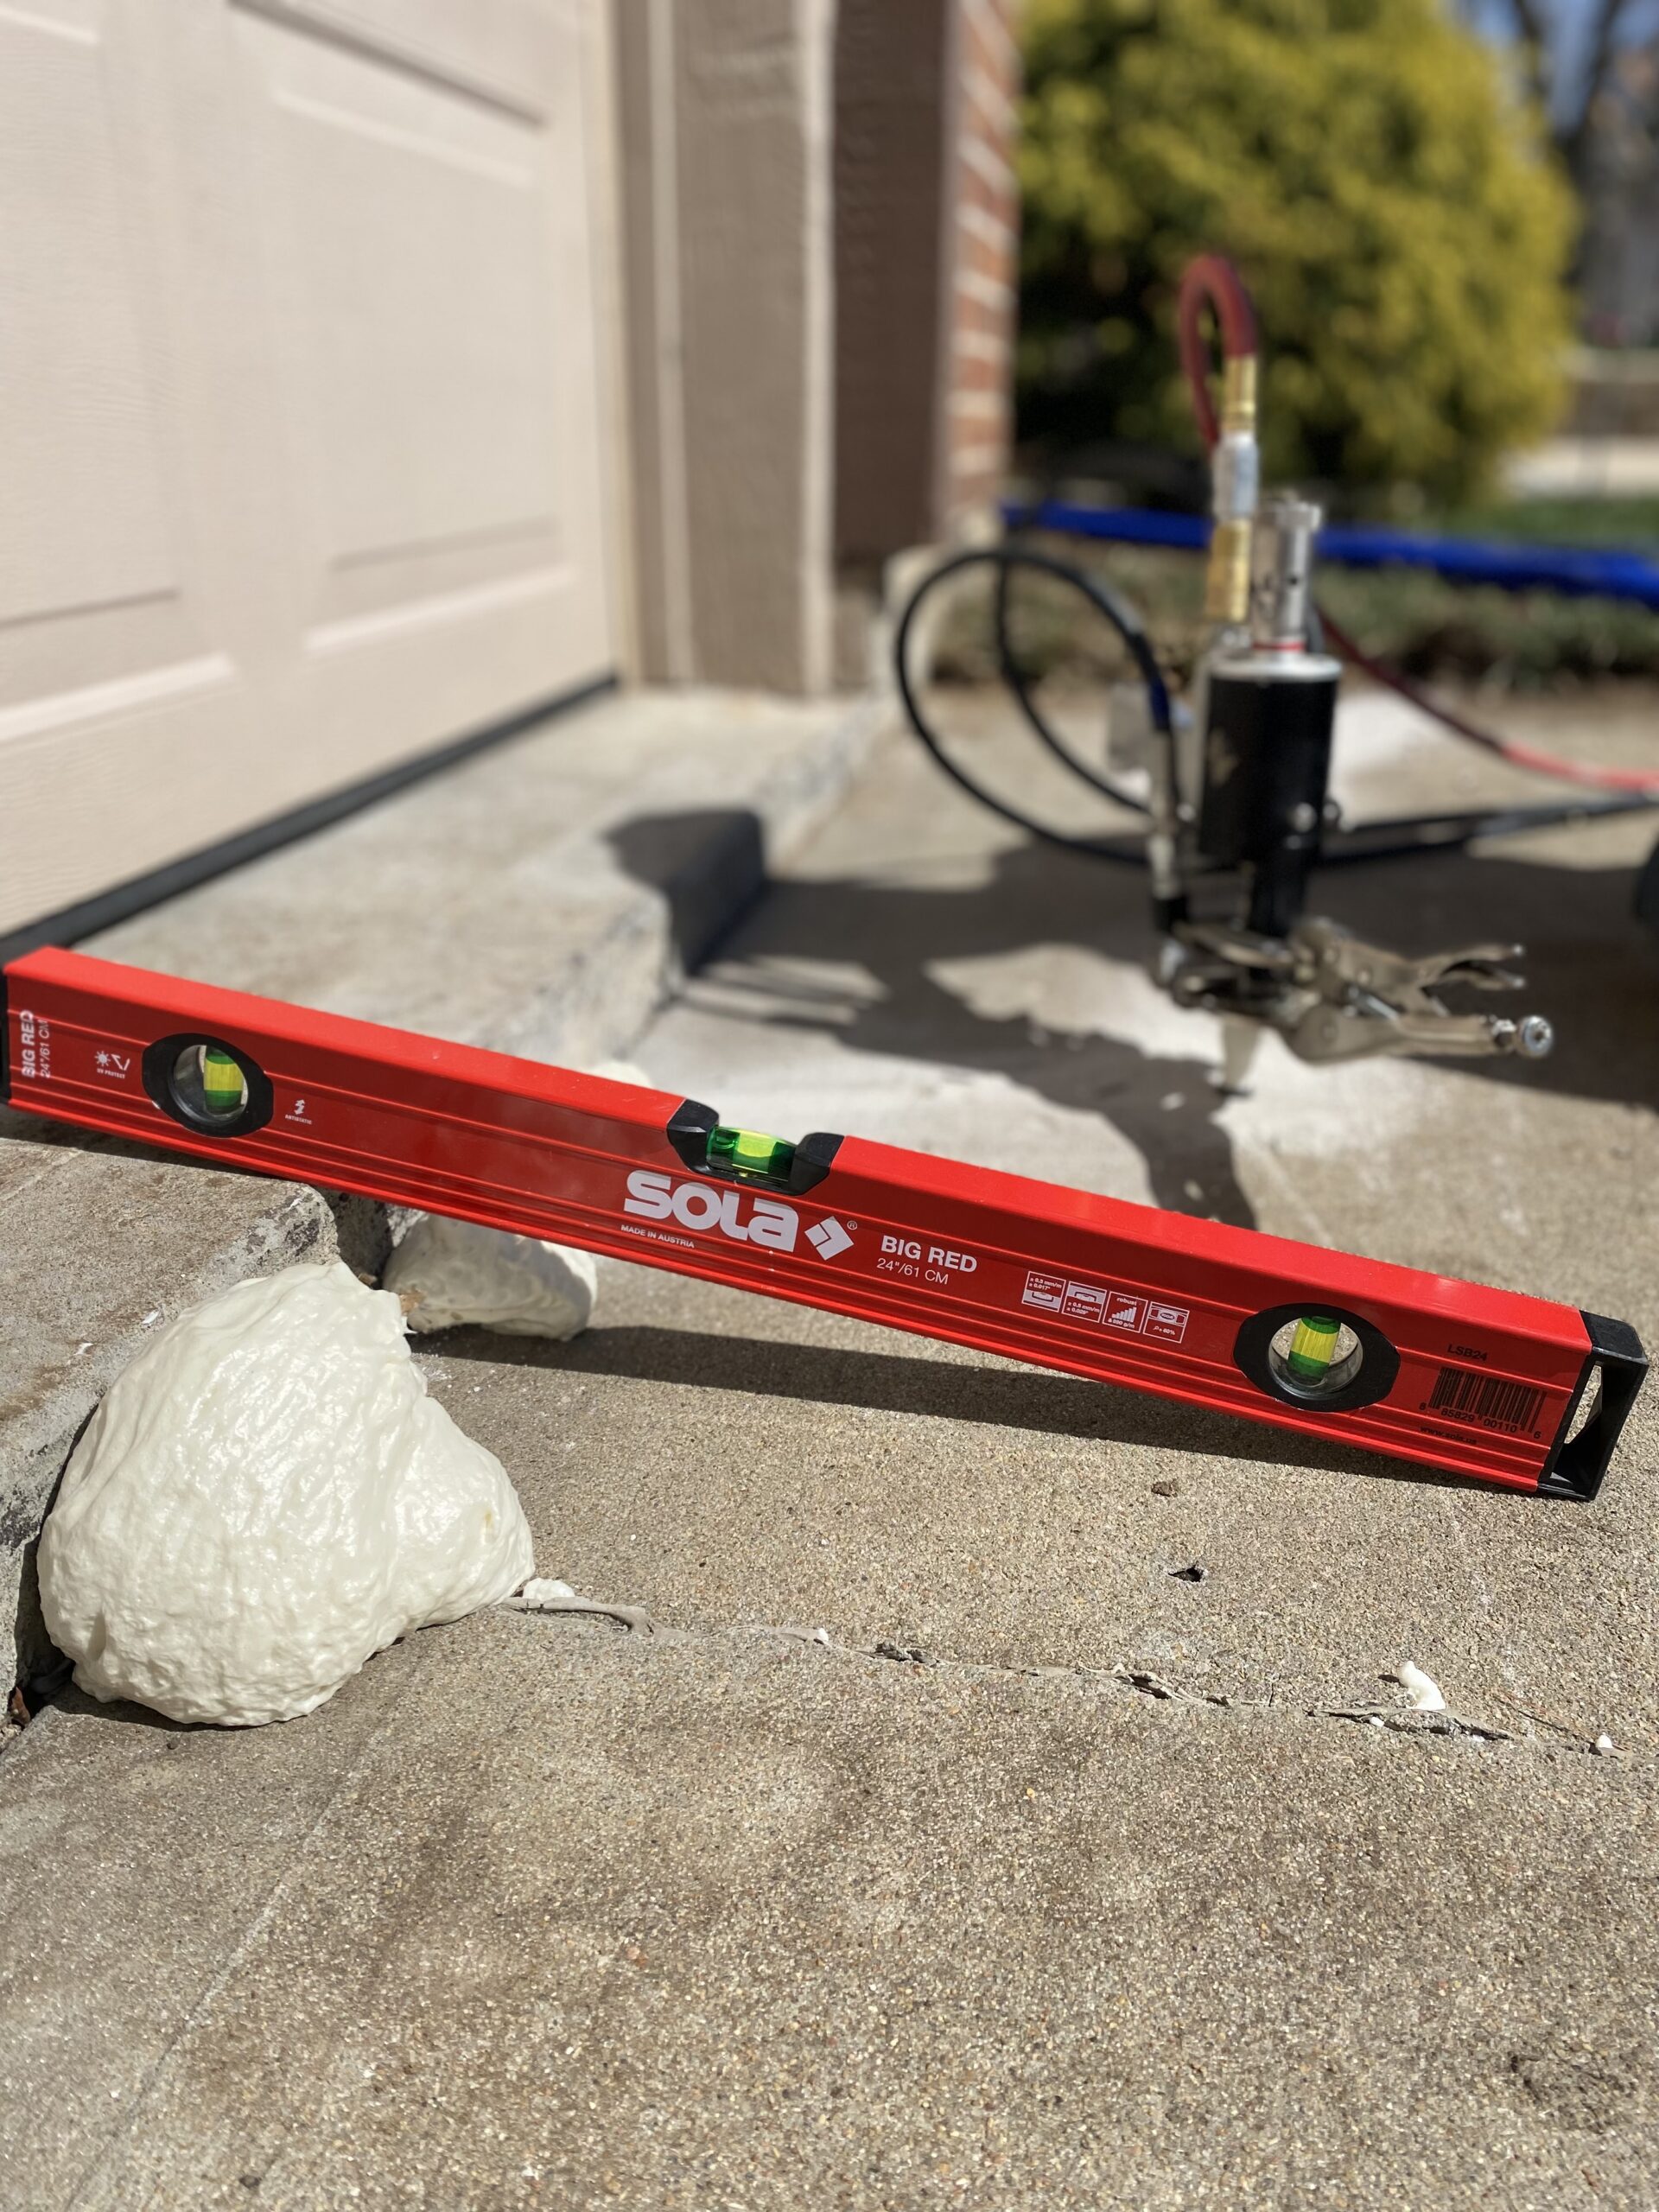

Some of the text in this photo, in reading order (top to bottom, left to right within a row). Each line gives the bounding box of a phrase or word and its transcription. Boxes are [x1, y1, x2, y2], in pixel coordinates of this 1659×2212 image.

[38, 1019, 49, 1039] CM
[20, 1009, 35, 1077] BIG RED
[620, 1224, 647, 1236] MADE
[658, 1233, 695, 1249] AUSTRIA
[880, 1235, 977, 1273] BIG RED
[876, 1257, 949, 1285] 24"/61 CM
[1447, 1344, 1488, 1361] LSB24
[1440, 1408, 1475, 1423] 85829
[1483, 1418, 1517, 1433] 00110
[1419, 1426, 1477, 1445] www.sola.us
